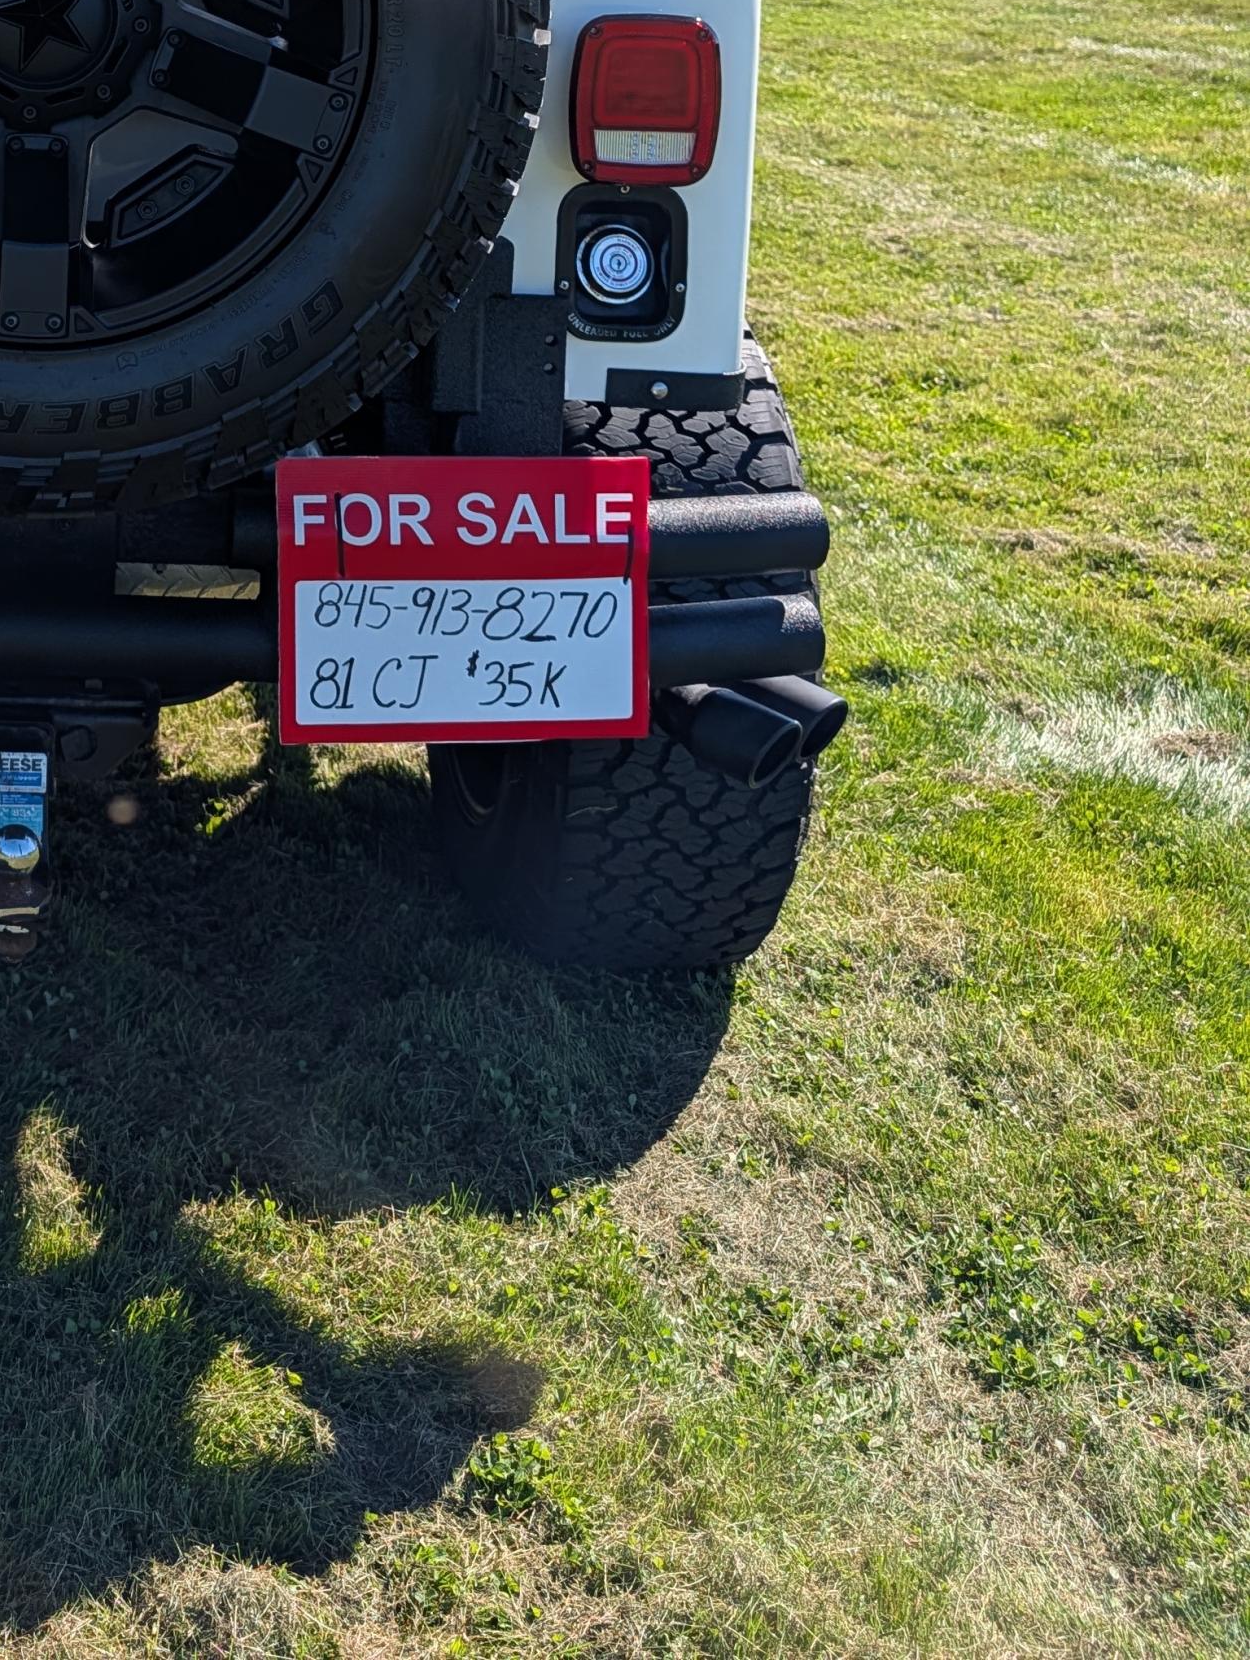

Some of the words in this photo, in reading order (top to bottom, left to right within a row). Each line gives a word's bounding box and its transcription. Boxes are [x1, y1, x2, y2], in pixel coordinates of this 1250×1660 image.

[567, 312, 617, 338] UNLEADED
[622, 329, 649, 338] FUEL
[653, 315, 677, 336] ONLY
[292, 492, 435, 547] FOR
[455, 492, 634, 546] SALE
[314, 582, 618, 643] 845-913-8270
[309, 657, 356, 709] 81
[372, 655, 439, 709] CJ
